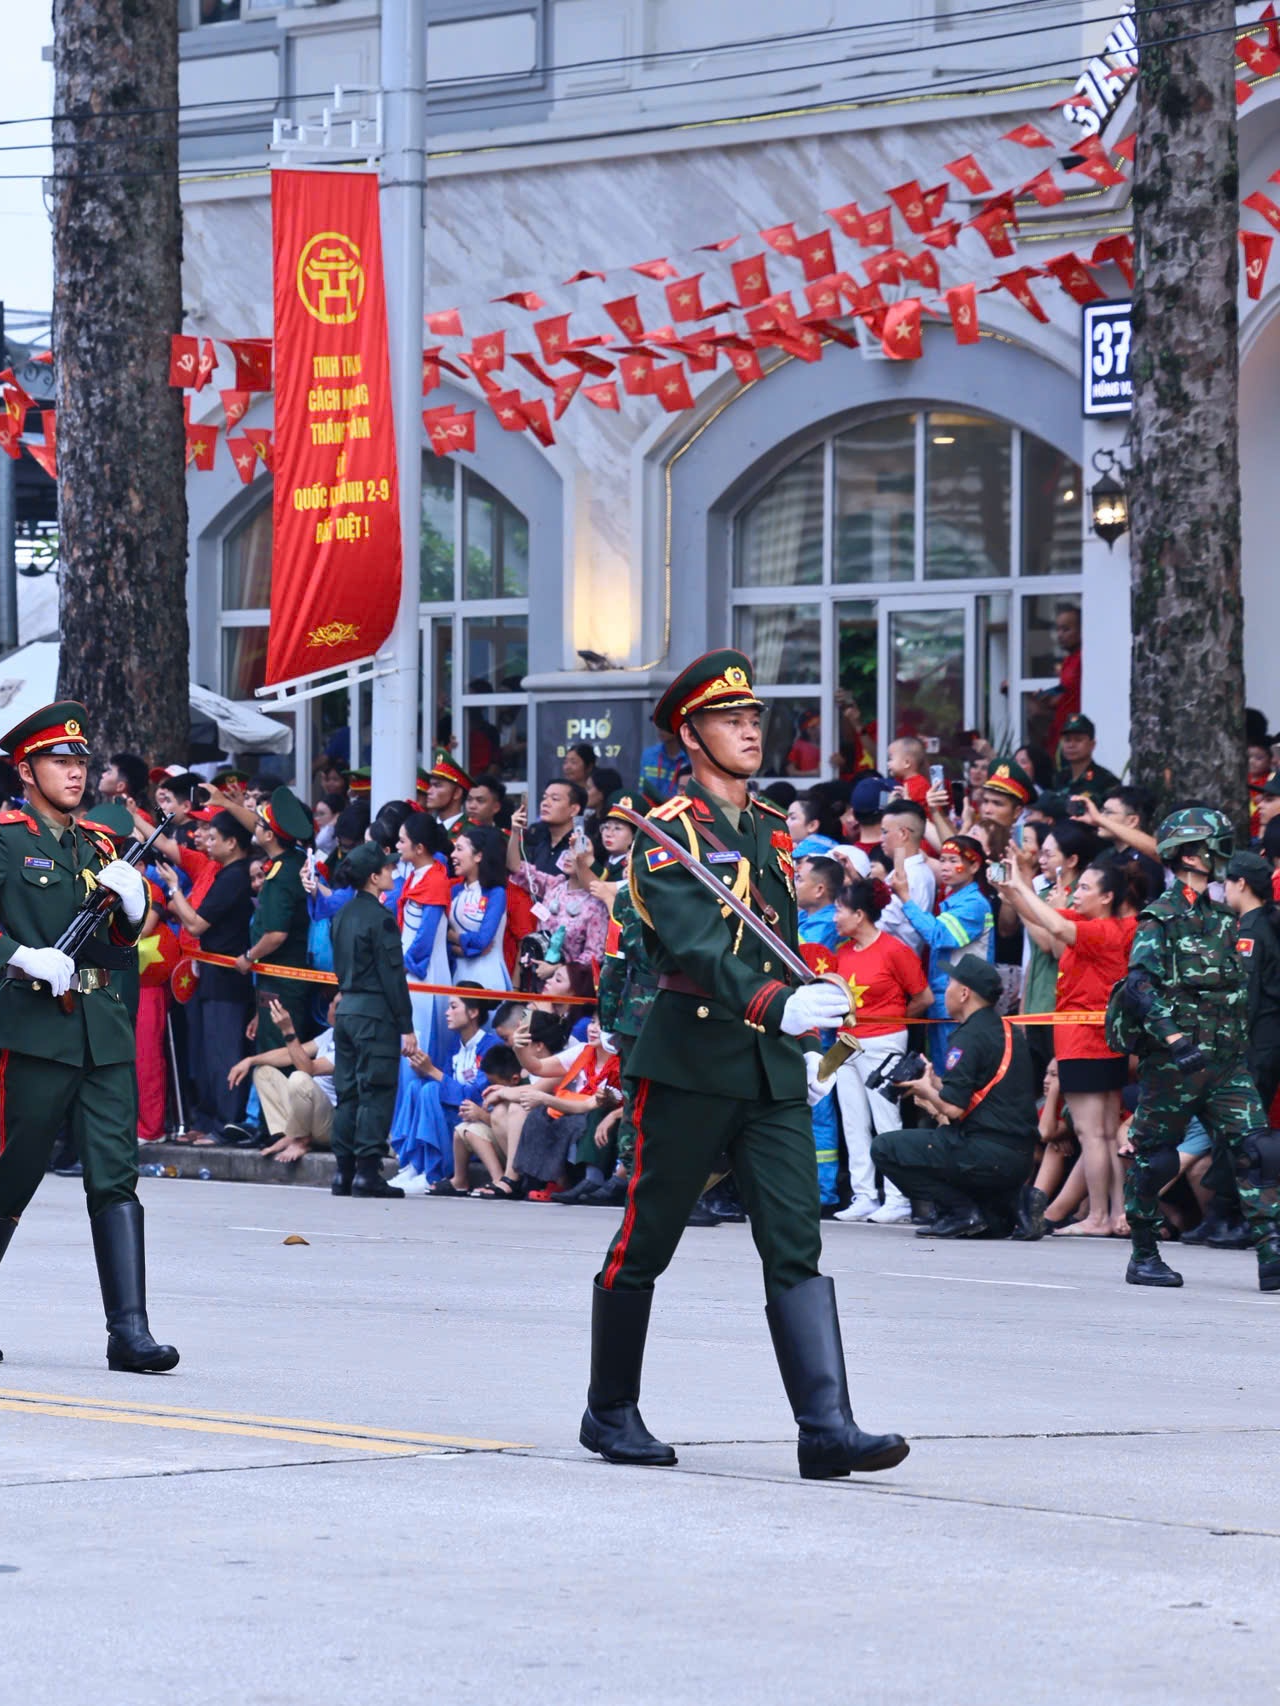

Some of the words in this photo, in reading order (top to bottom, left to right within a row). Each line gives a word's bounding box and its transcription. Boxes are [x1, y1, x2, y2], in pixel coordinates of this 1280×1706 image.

[1062, 56, 1126, 137] 37A
[1093, 320, 1132, 376] 37
[312, 355, 340, 378] TINH
[308, 385, 341, 412] CÁCH
[342, 384, 369, 411] MNG
[310, 418, 346, 445] THÁN
[346, 413, 371, 439] ÁM
[294, 482, 328, 511] QUỐC
[367, 478, 389, 502] 2-9
[336, 511, 362, 544] DIỆT
[364, 515, 370, 538] !
[604, 744, 622, 758] 37
